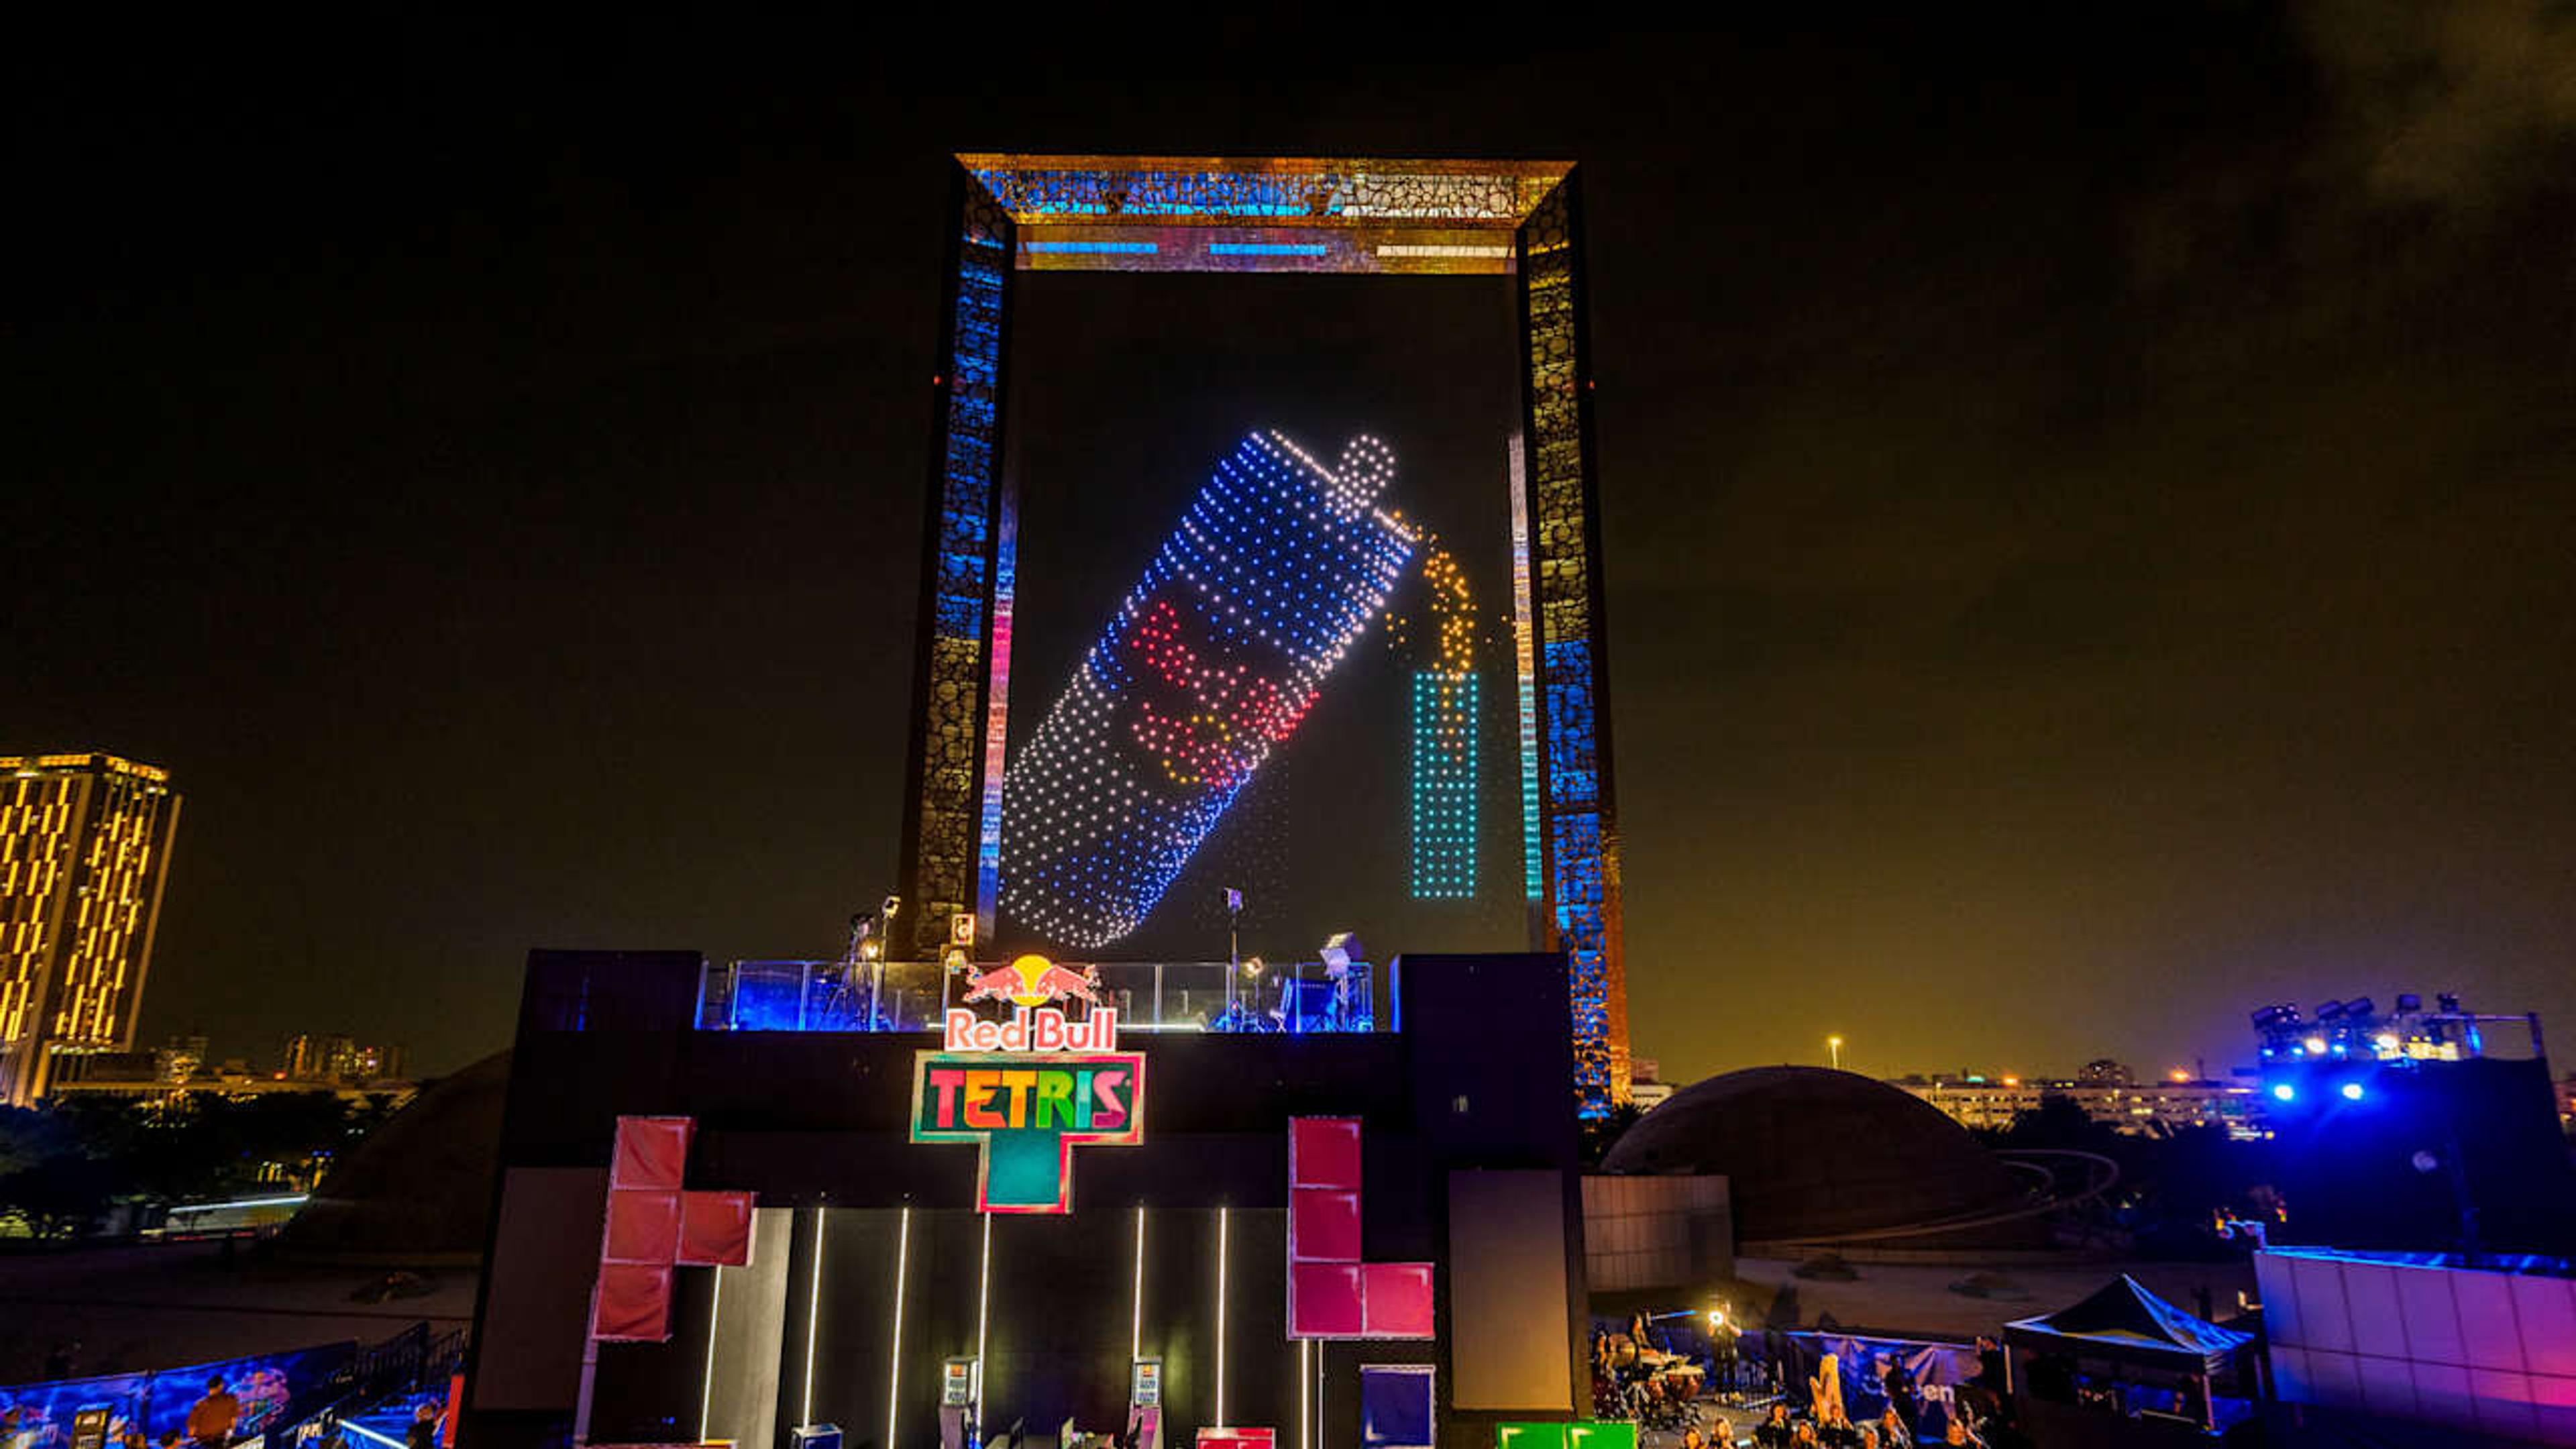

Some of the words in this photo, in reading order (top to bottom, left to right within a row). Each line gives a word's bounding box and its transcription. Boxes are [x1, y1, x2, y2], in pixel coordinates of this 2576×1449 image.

[947, 1010, 1026, 1048] Red
[1036, 1010, 1114, 1048] Bull
[930, 1070, 1127, 1128] TETRIS
